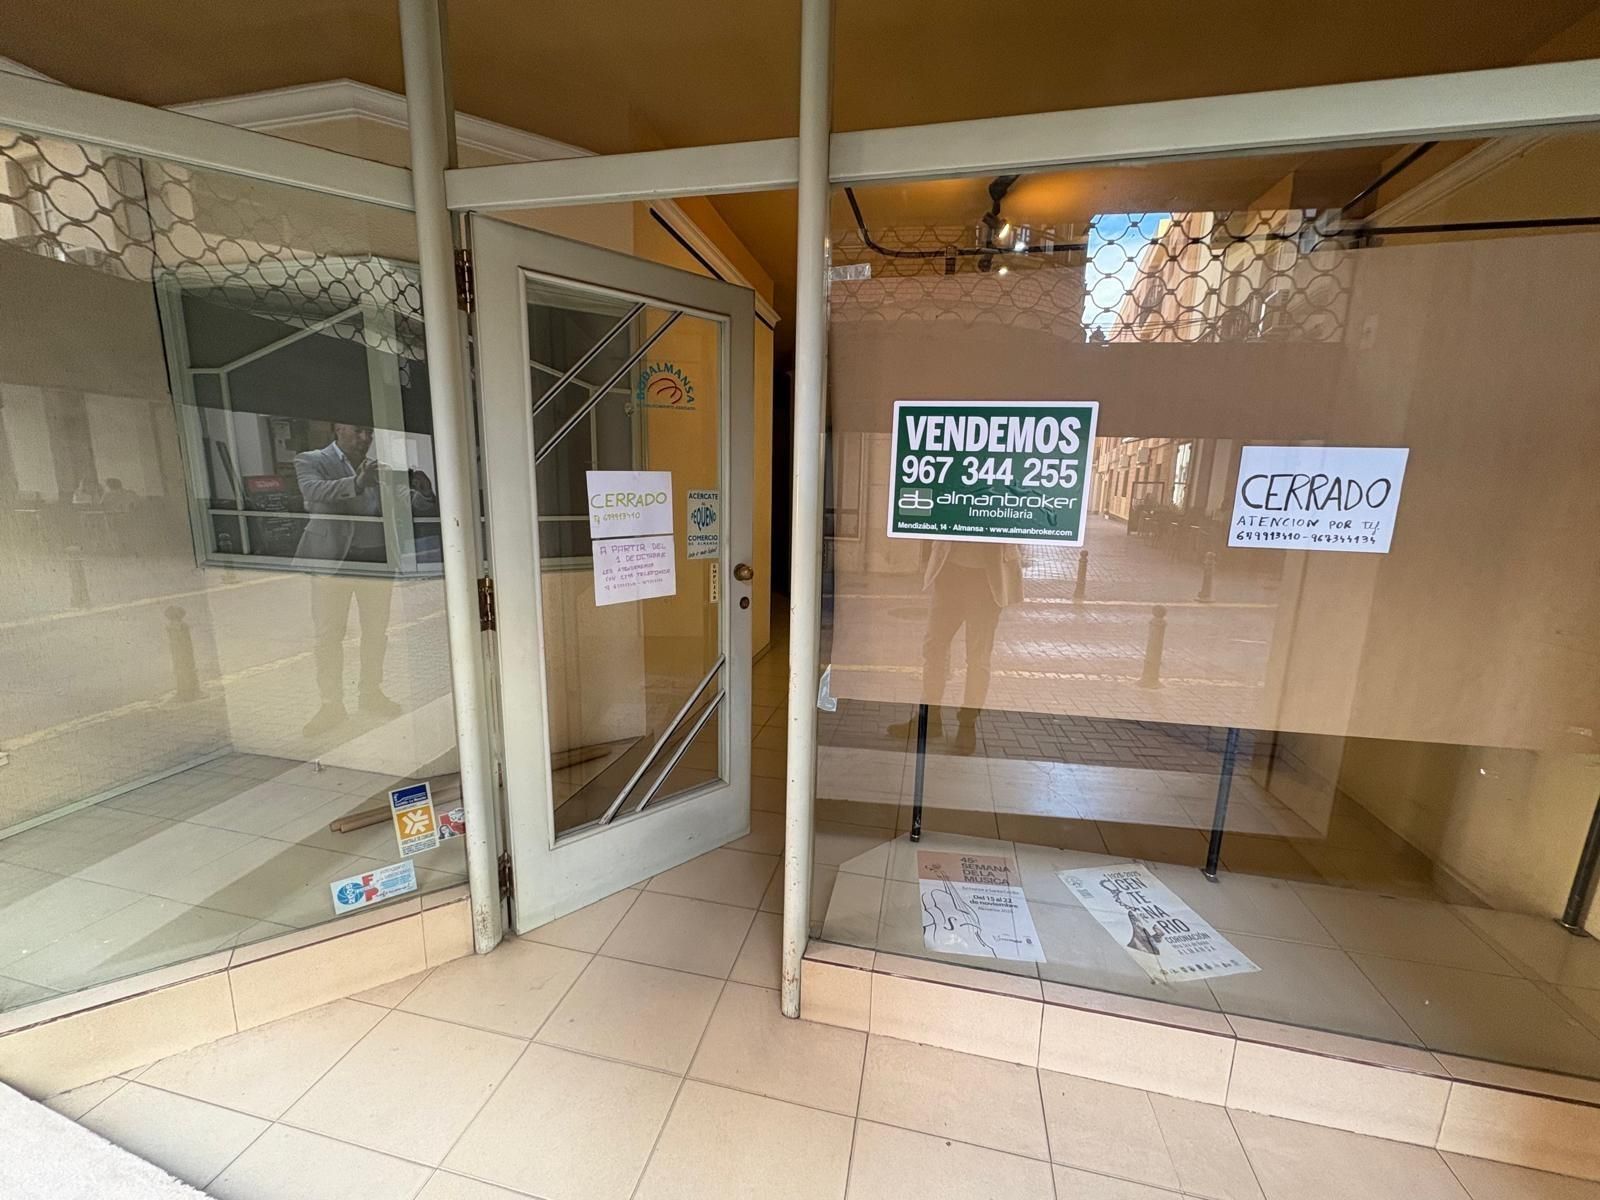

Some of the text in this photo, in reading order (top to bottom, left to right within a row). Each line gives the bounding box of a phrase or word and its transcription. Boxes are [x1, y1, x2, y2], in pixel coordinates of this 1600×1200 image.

[905, 415, 1082, 454] VENDEMOS
[902, 455, 1079, 488] 967 344 255
[1241, 473, 1392, 512] CERRADO
[590, 491, 668, 509] CERRADO
[936, 491, 1078, 510] almanbroker
[968, 507, 1033, 520] Inmobiliaria
[898, 521, 938, 531] Mendizábal,
[953, 524, 984, 532] Almansa
[989, 526, 1073, 537] www.almanbroker.com
[1236, 515, 1320, 528] ATENCION
[1329, 519, 1353, 529] POR
[611, 543, 646, 553] PARTIR
[652, 542, 667, 550] DEL
[961, 863, 1012, 873] SEMANA
[979, 870, 996, 878] LA
[1114, 877, 1148, 891] CEN
[979, 901, 1018, 909] noviembre
[1126, 891, 1152, 905] TE
[1141, 904, 1171, 919] NA
[1156, 918, 1191, 935] RIO
